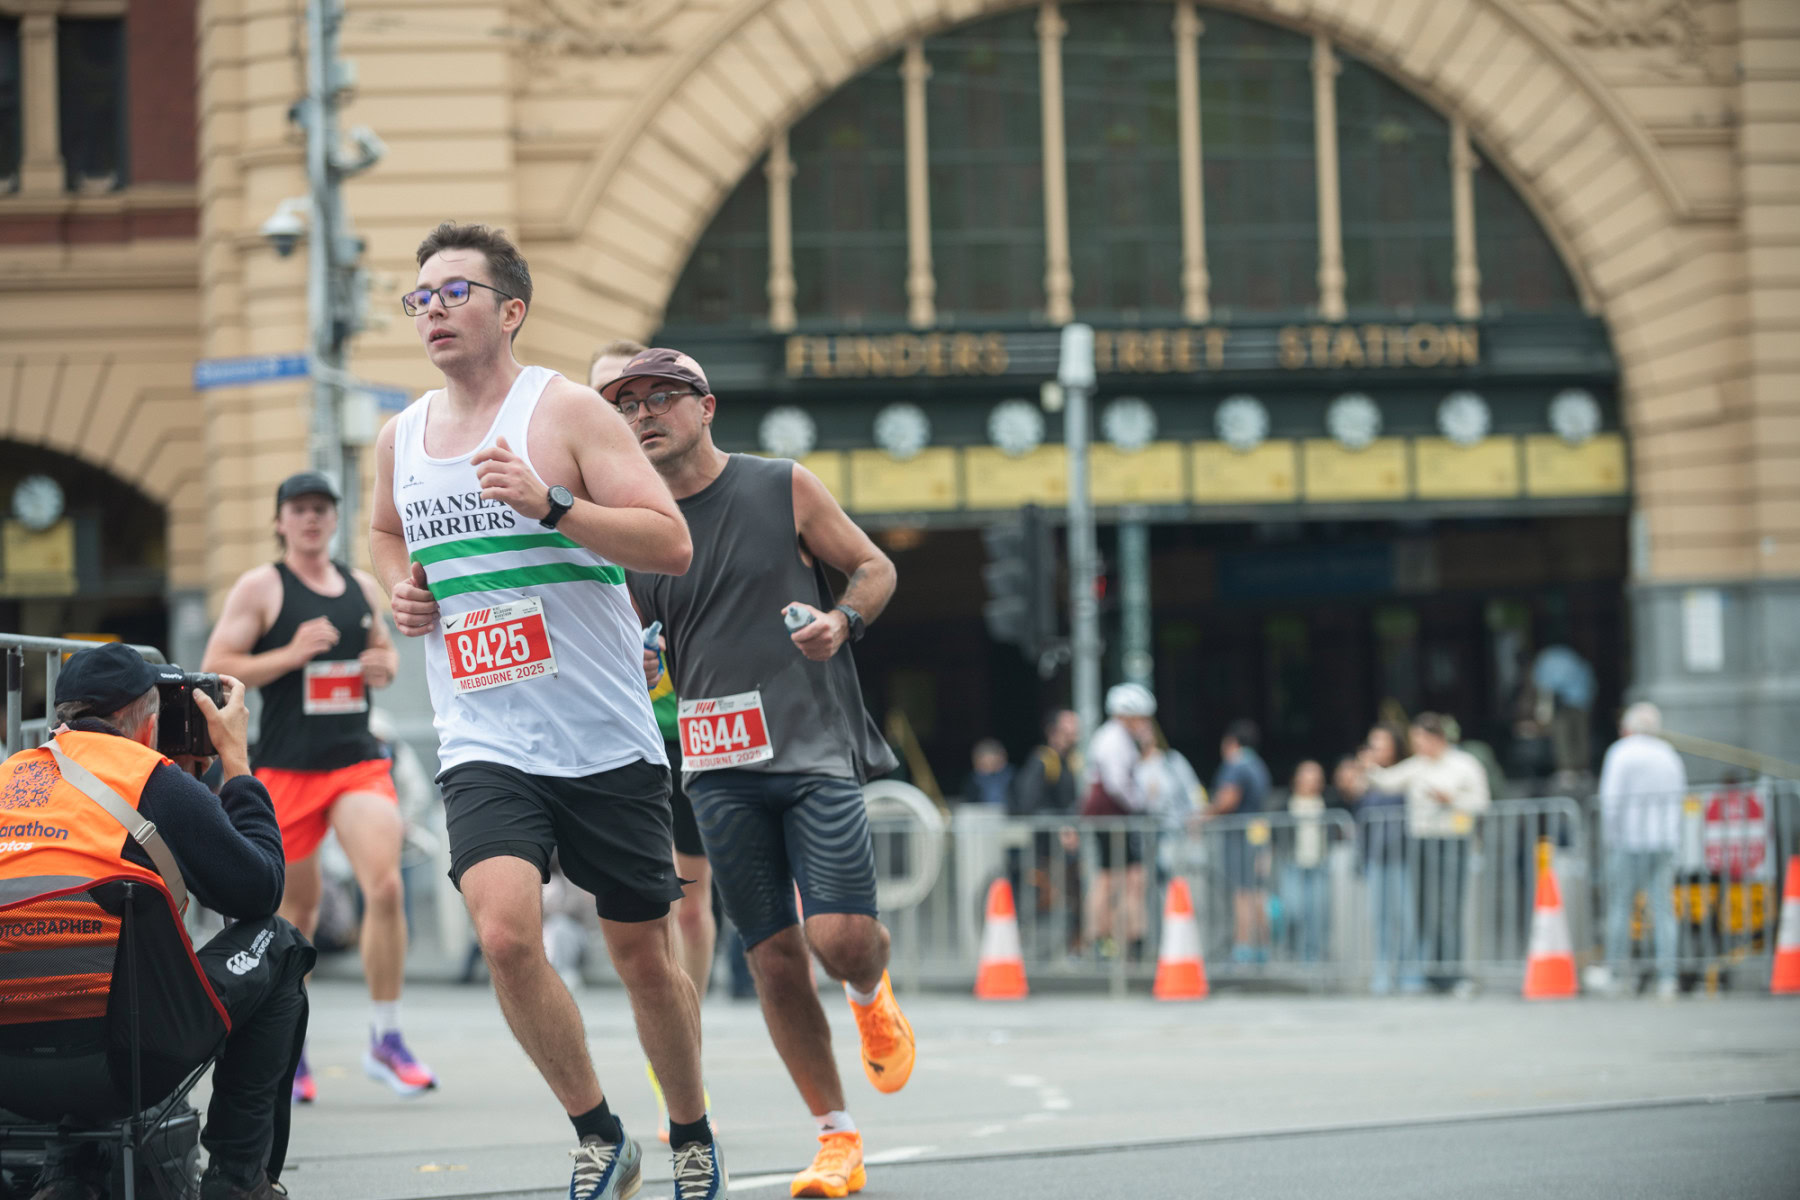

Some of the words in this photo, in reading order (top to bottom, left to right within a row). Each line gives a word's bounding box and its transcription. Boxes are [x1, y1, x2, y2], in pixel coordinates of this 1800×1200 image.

[1095, 327, 1226, 374] TREET
[1279, 323, 1479, 371] STATION
[405, 510, 516, 544] HARRIERS
[457, 622, 531, 674] 8425
[460, 670, 513, 690] MELBOURNE
[515, 663, 545, 679] 2025
[688, 713, 751, 755] 6944
[0, 919, 103, 938] TOGRAPHER
